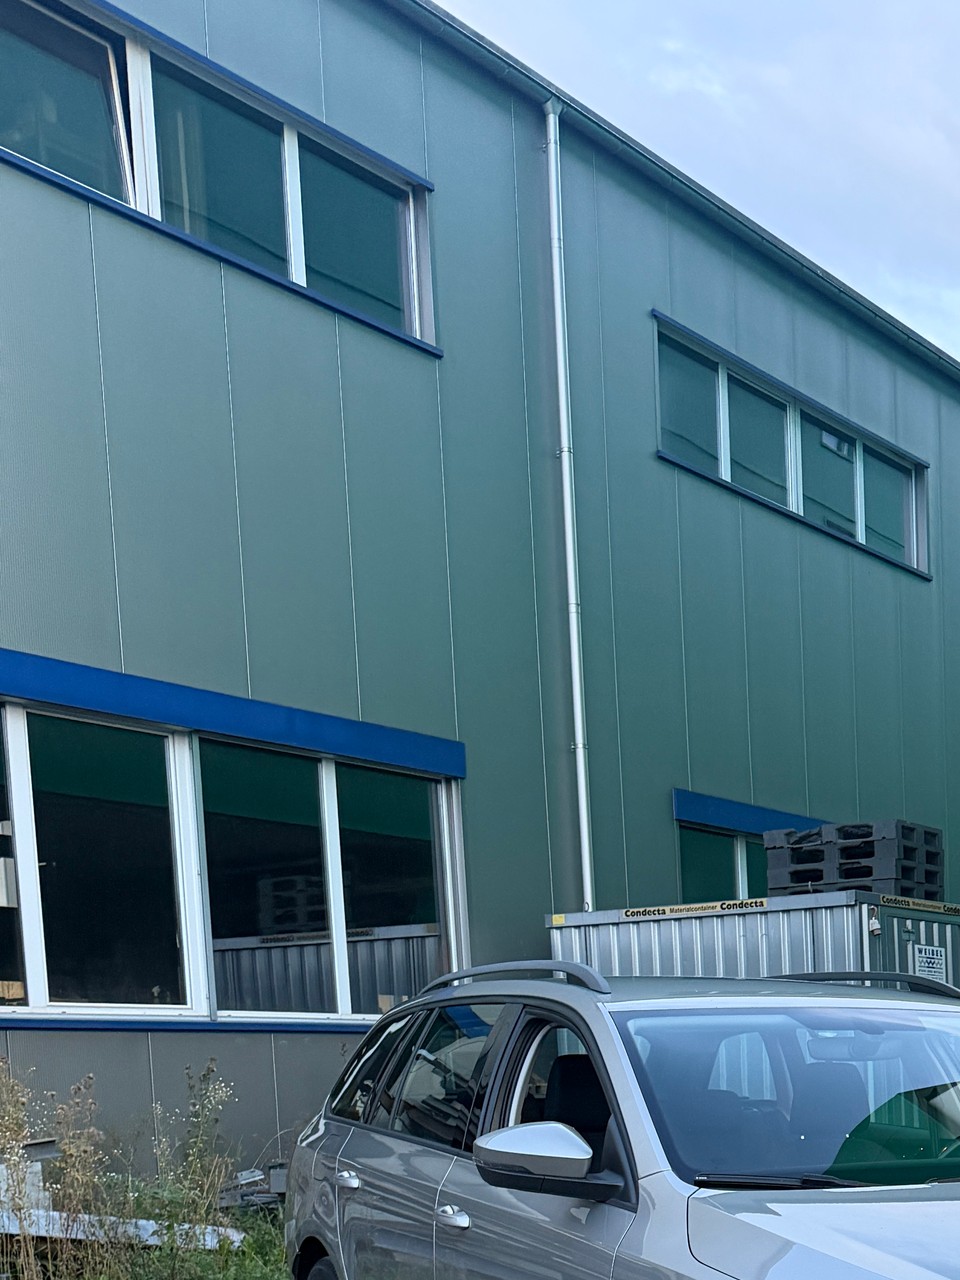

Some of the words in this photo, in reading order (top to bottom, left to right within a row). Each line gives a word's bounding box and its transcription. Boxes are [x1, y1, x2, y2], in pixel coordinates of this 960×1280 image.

[624, 908, 666, 918] Condecta
[669, 904, 718, 914] Materialcontainer
[720, 900, 765, 911] Condecta
[917, 947, 943, 958] WEIBEL
